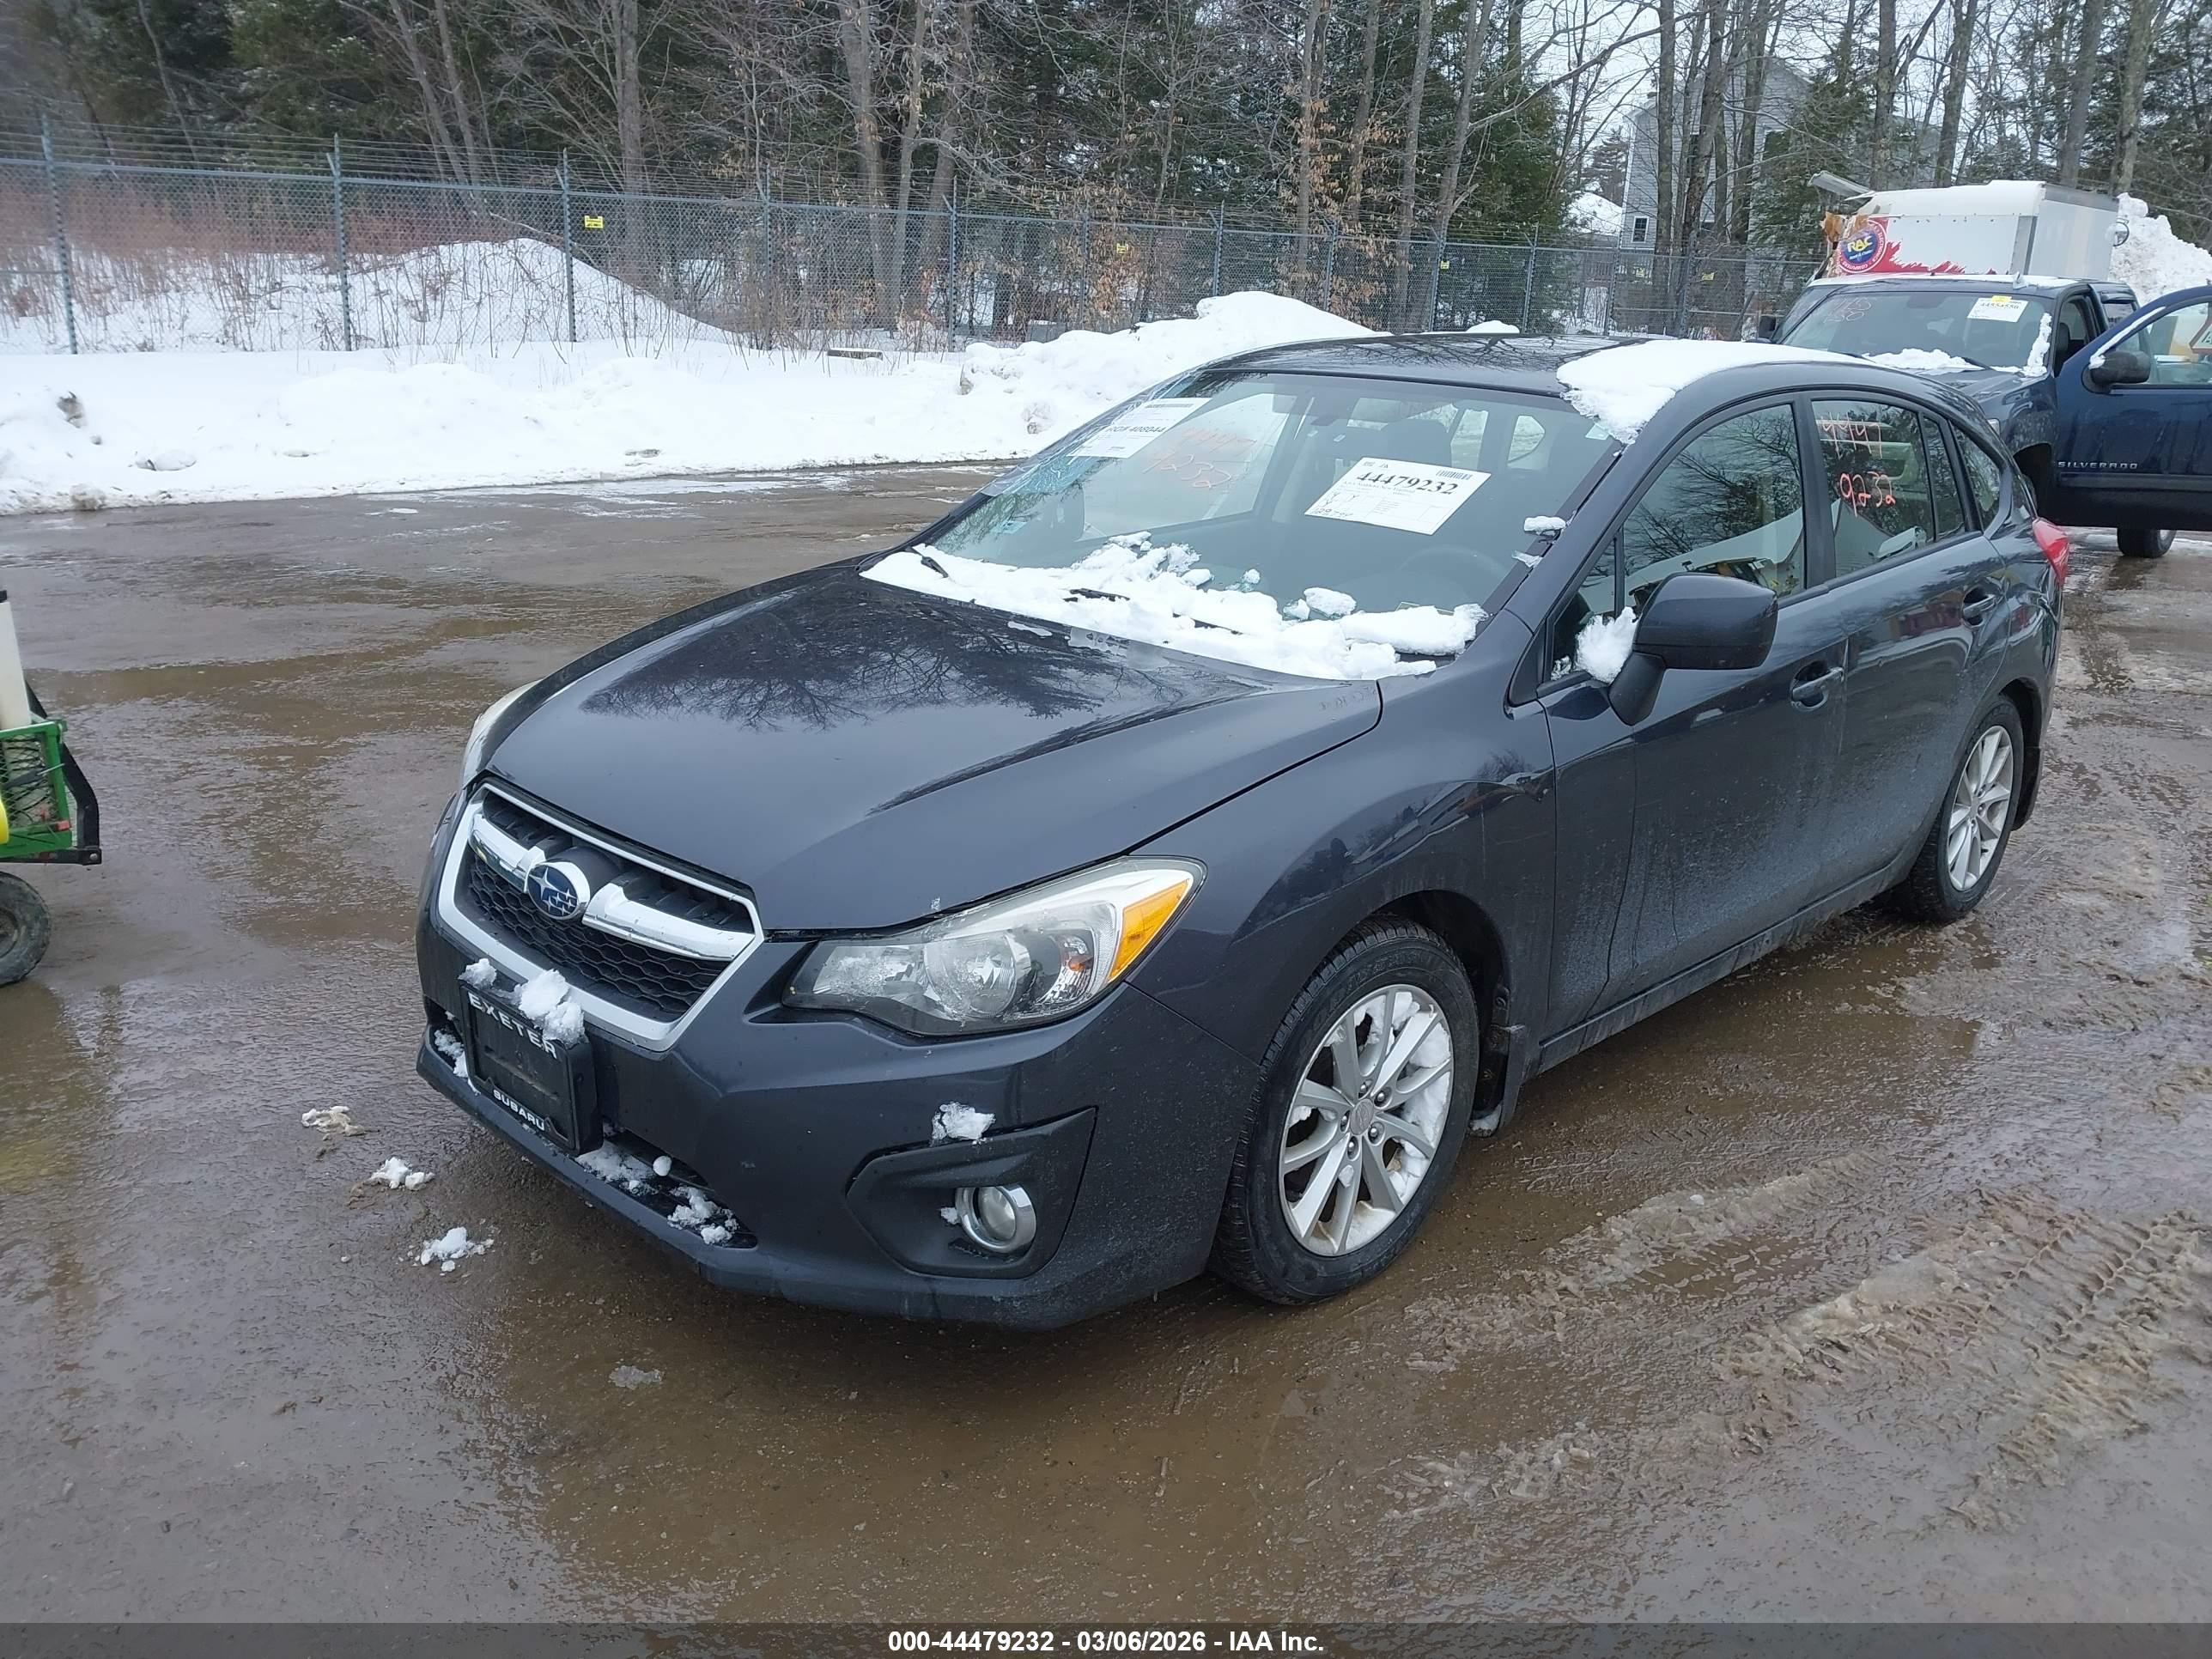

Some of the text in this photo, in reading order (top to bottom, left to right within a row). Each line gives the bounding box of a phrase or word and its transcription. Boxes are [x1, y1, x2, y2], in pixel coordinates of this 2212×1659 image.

[1847, 234, 1873, 253] RAC
[2057, 461, 2138, 470] SILVERADO
[1356, 471, 1459, 495] 44479232
[1839, 472, 1896, 518] 9232
[468, 992, 557, 1059] EXETER
[494, 1089, 544, 1131] SUBARU
